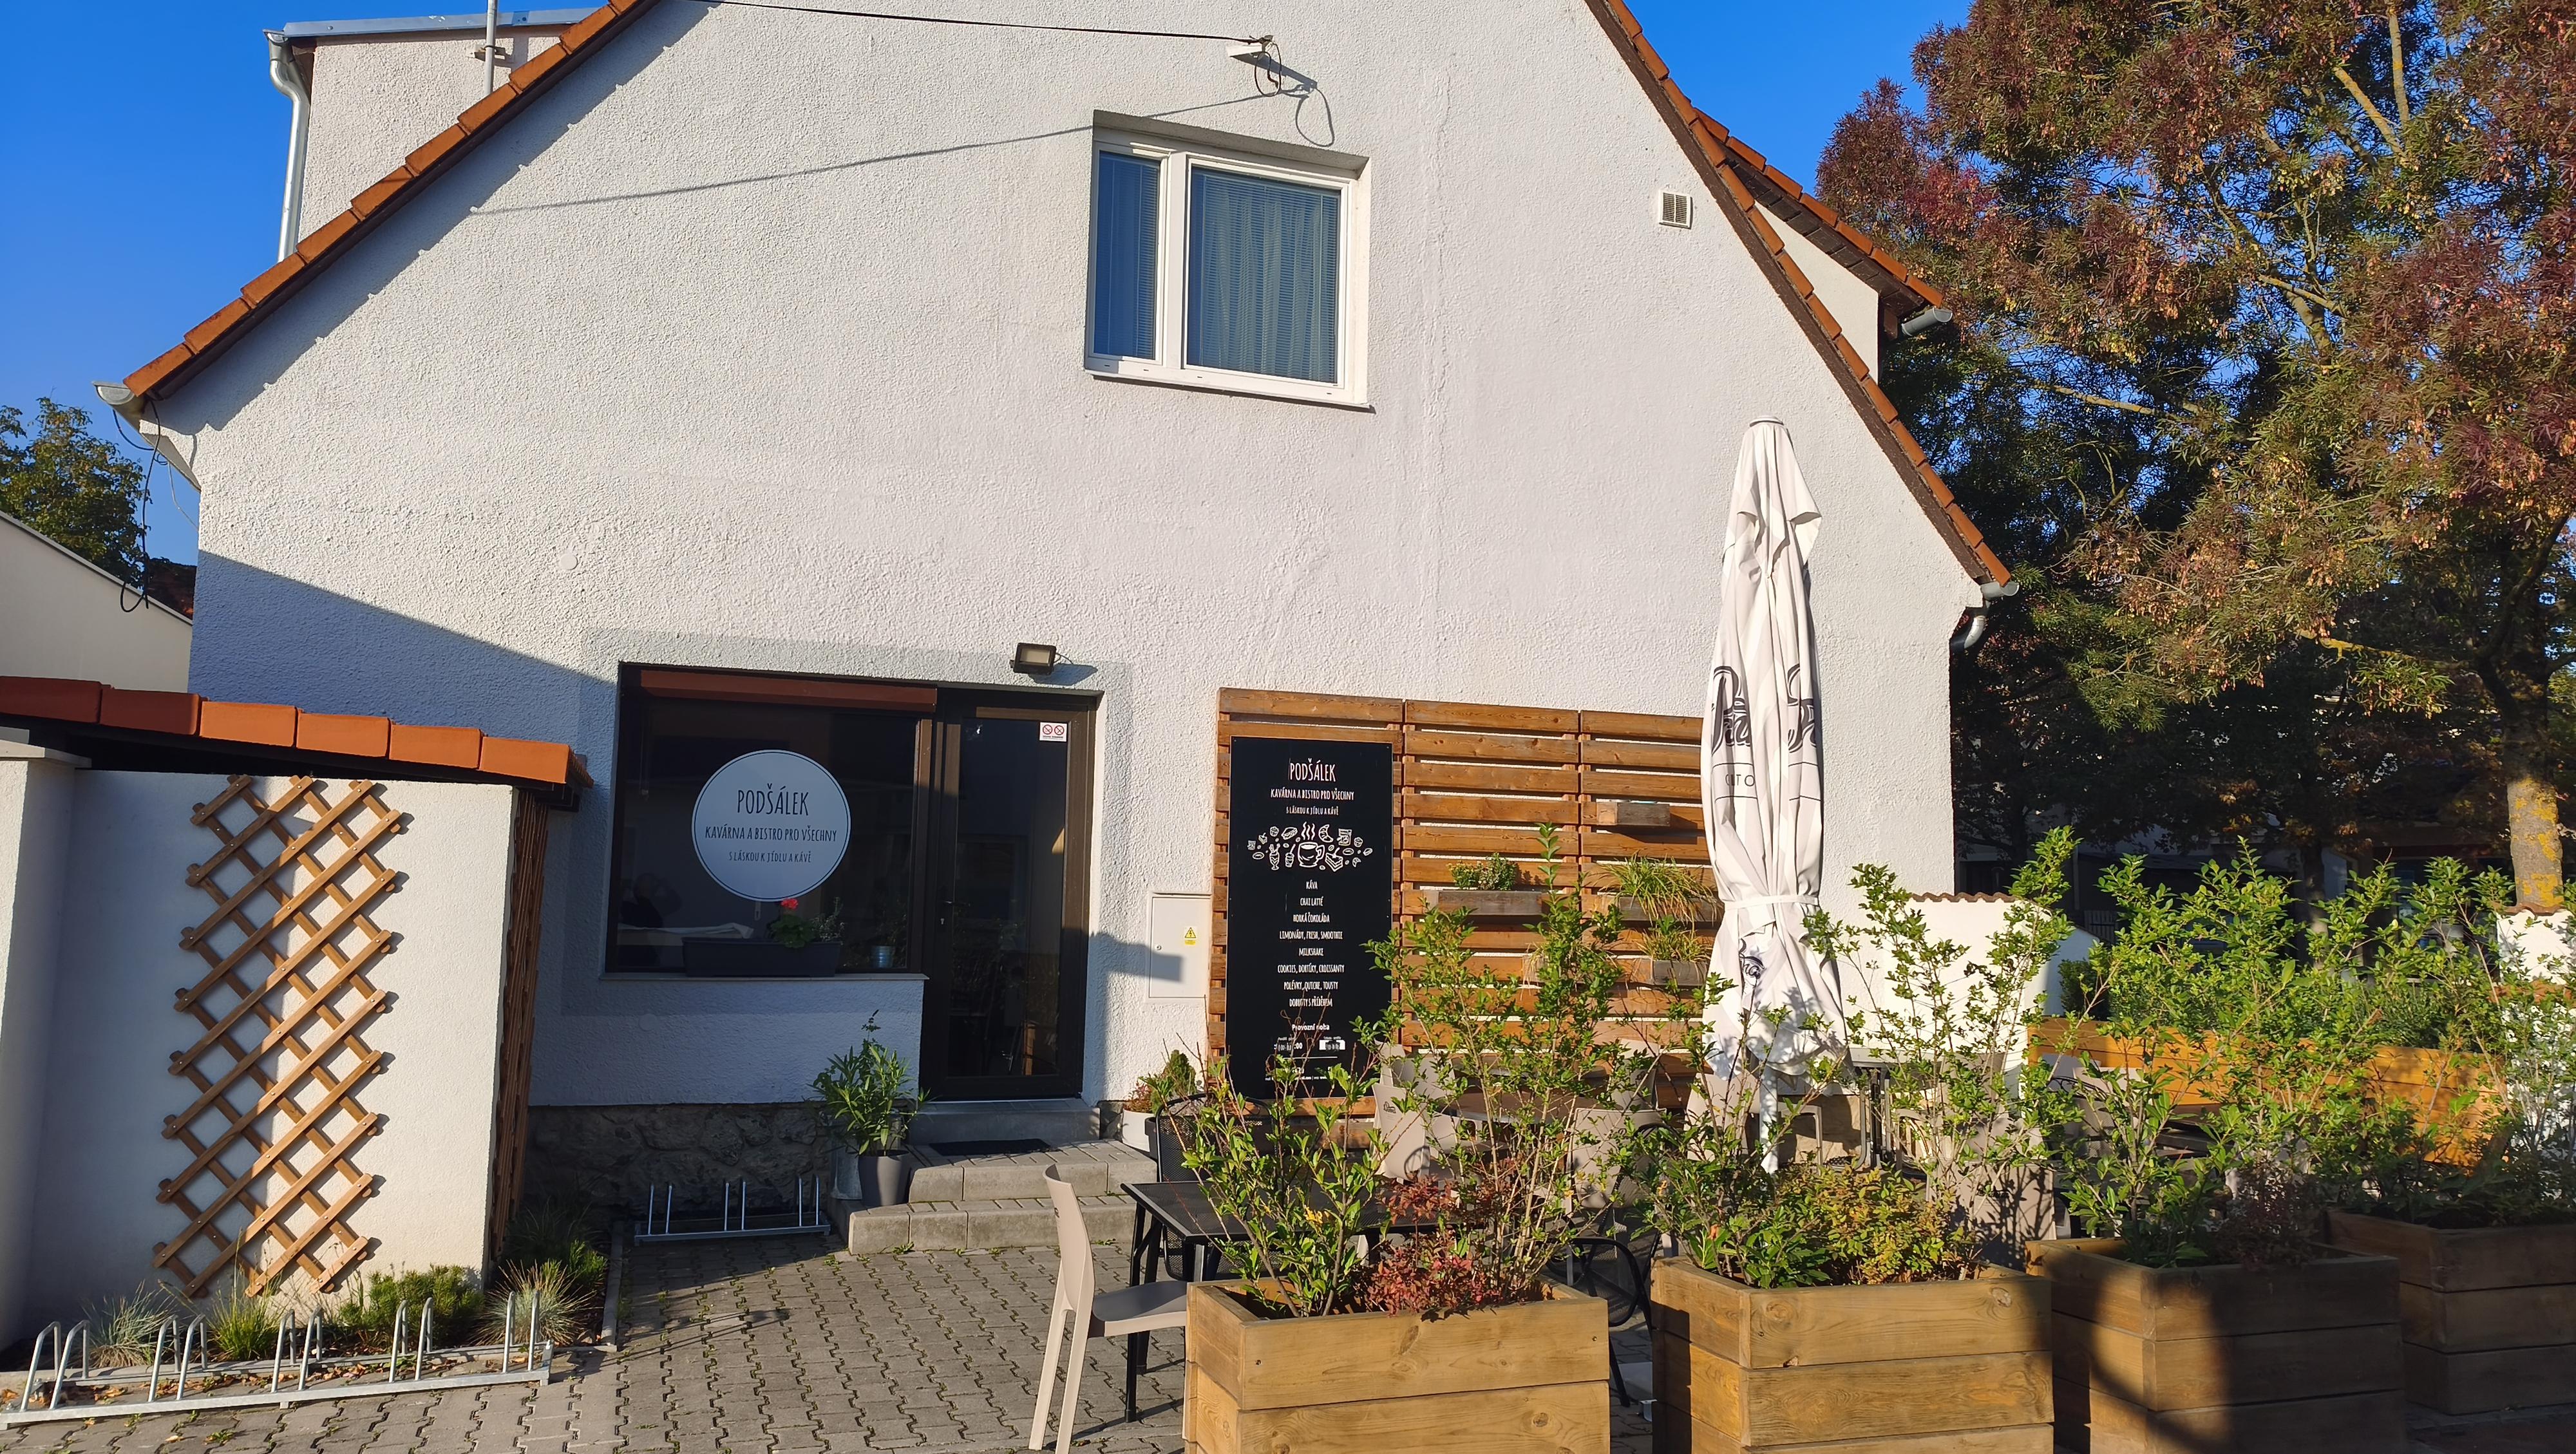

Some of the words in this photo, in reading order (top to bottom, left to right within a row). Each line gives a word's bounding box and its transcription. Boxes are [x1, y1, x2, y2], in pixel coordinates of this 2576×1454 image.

[1290, 757, 1336, 782] PODŠÁLEK
[1271, 786, 1296, 798] KAVÁRNA
[1297, 789, 1301, 799] A
[1302, 789, 1320, 800] BISTRO
[1320, 790, 1331, 800] PRO
[1331, 788, 1354, 800] VŠECHNY
[737, 783, 809, 816] PODŠÁLEK
[1289, 805, 1306, 814] LÁSKOU
[1310, 806, 1323, 815] JÍDLU
[1327, 806, 1339, 816] KÁVĚ
[705, 824, 745, 840] KAVÁRNA
[747, 827, 753, 840] A
[755, 827, 782, 841] BISTRO
[785, 828, 799, 841] PRO
[802, 825, 837, 842] VŠECHNY
[729, 851, 732, 861] S
[734, 849, 759, 862] LÁSKOU
[761, 853, 765, 862] K
[766, 850, 787, 863] JÍDLU
[789, 853, 793, 863] A
[795, 851, 811, 863] KÁVĚ
[1306, 880, 1318, 889] KÁVA
[1300, 898, 1311, 906] CHAI
[1293, 912, 1307, 923] HORKÁ
[1308, 912, 1330, 923] ČOKOLÁDA
[1320, 931, 1343, 939] SMOOTHIE
[1299, 948, 1324, 956] MILKSHAKE
[1318, 965, 1345, 973] CROISSANTY
[1323, 981, 1339, 990] TOUSTY
[1309, 998, 1311, 1006] S
